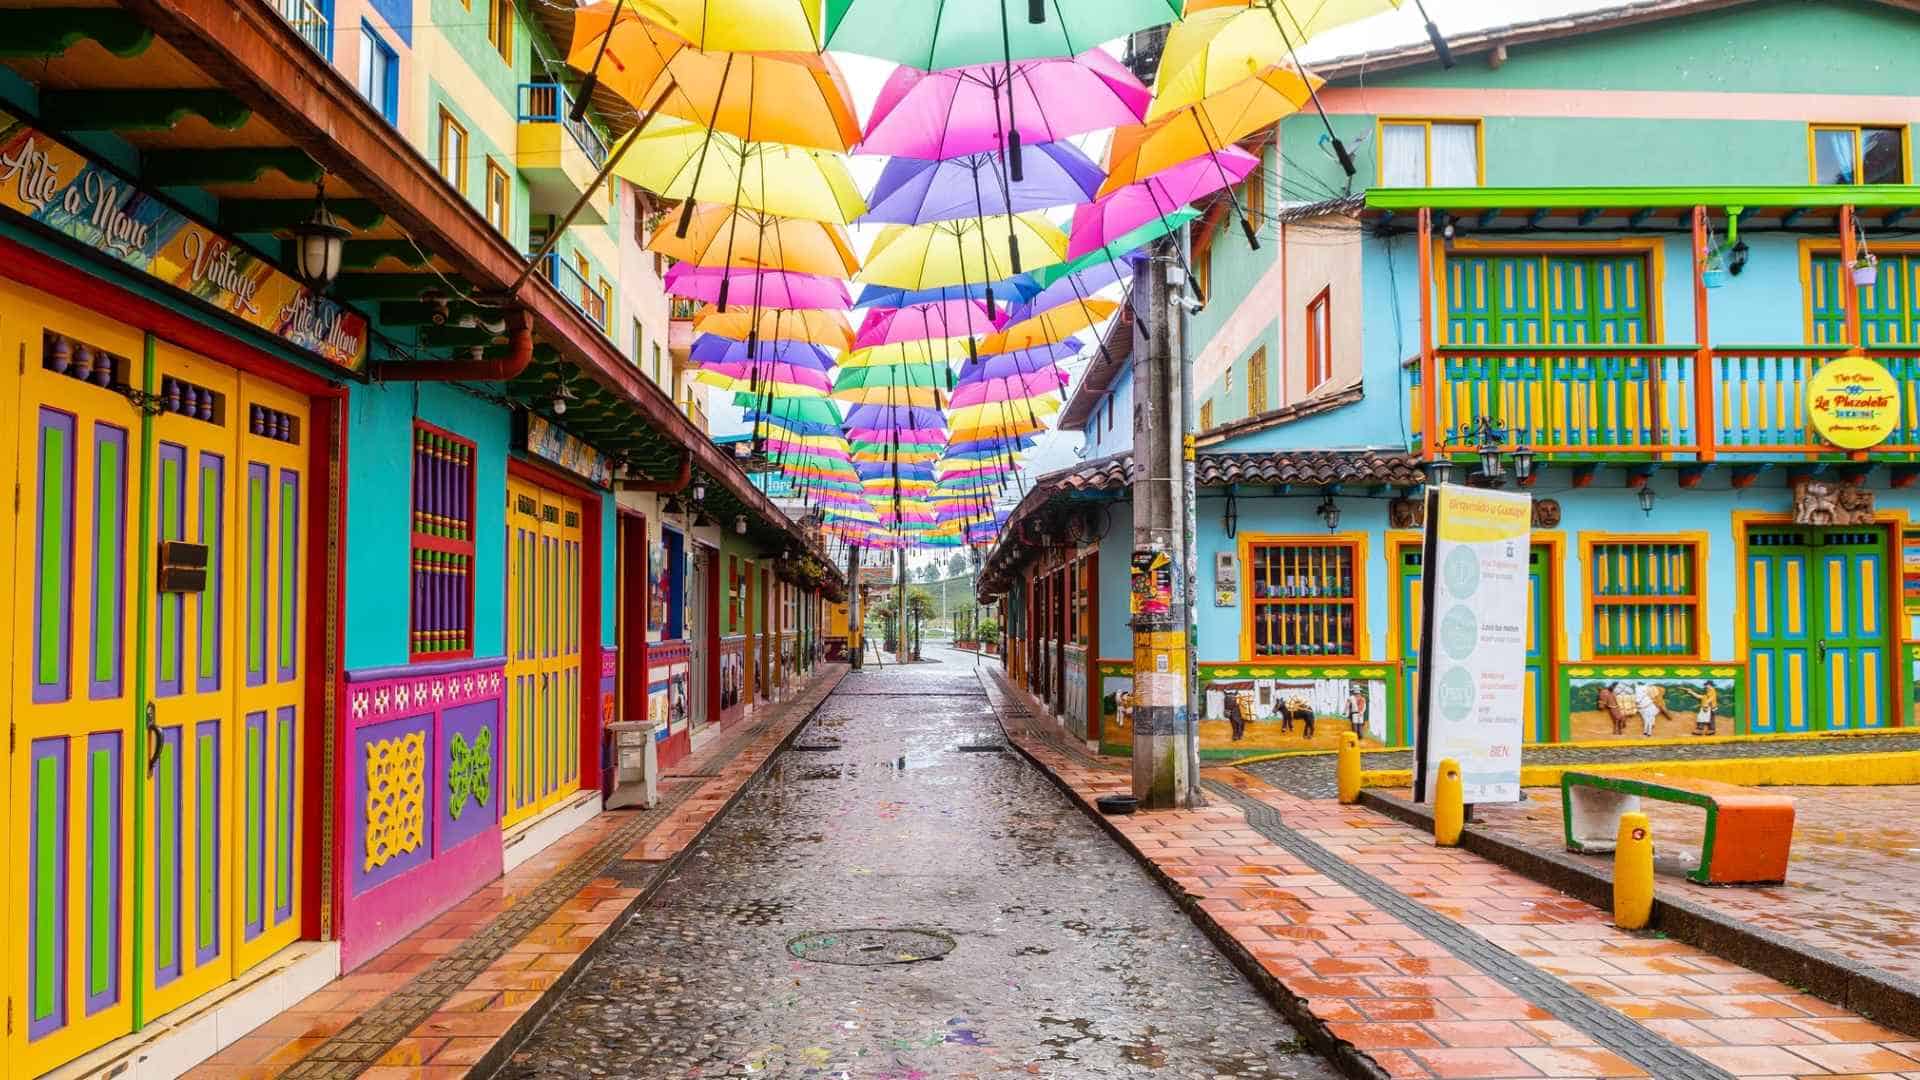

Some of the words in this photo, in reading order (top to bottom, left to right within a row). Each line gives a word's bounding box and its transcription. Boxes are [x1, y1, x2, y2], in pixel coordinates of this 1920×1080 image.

[64, 186, 80, 215] a
[84, 170, 149, 257] Mano
[184, 231, 260, 315] Vintage
[324, 304, 358, 364] Mano
[1814, 395, 1830, 411] La
[1833, 395, 1895, 408] Plazoleta
